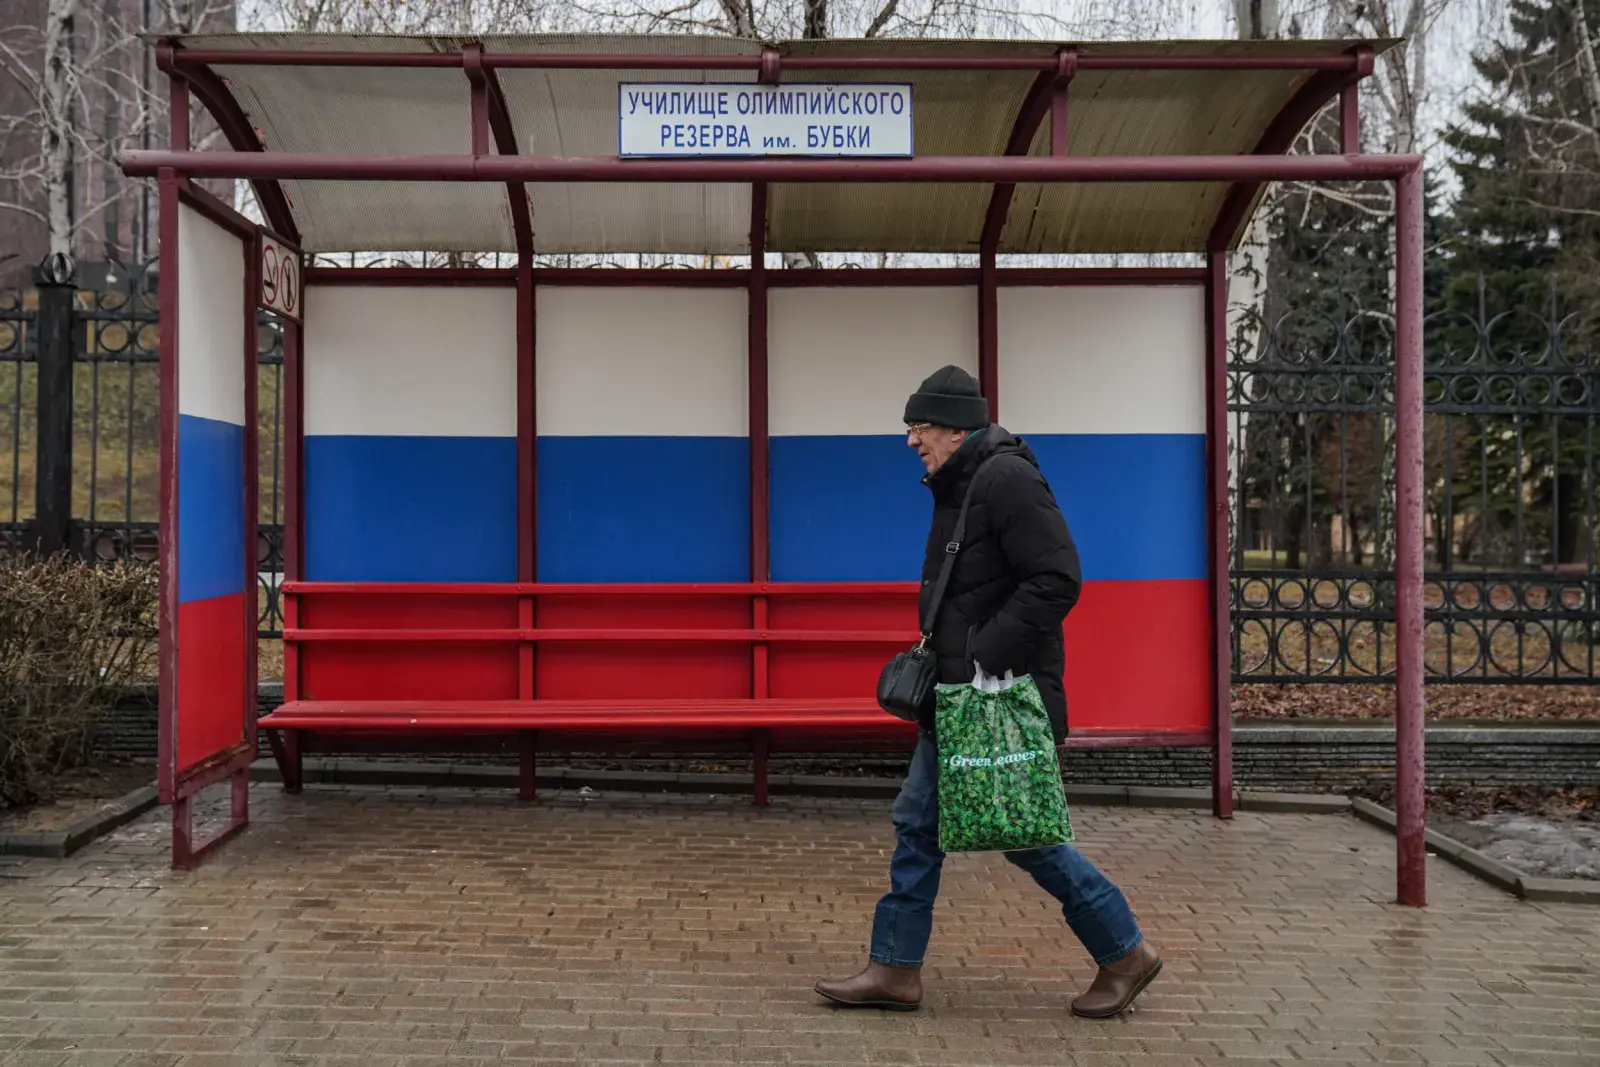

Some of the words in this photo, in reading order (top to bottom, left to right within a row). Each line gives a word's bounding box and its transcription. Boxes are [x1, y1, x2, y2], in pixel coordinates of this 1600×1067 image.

[628, 91, 729, 118] УЧИЛИЩЕ
[737, 87, 904, 115] ОЛИМПИЙСКОГО
[661, 125, 751, 148] РЕЗЕРВА
[763, 136, 797, 148] им.
[807, 125, 871, 148] БУБКИ
